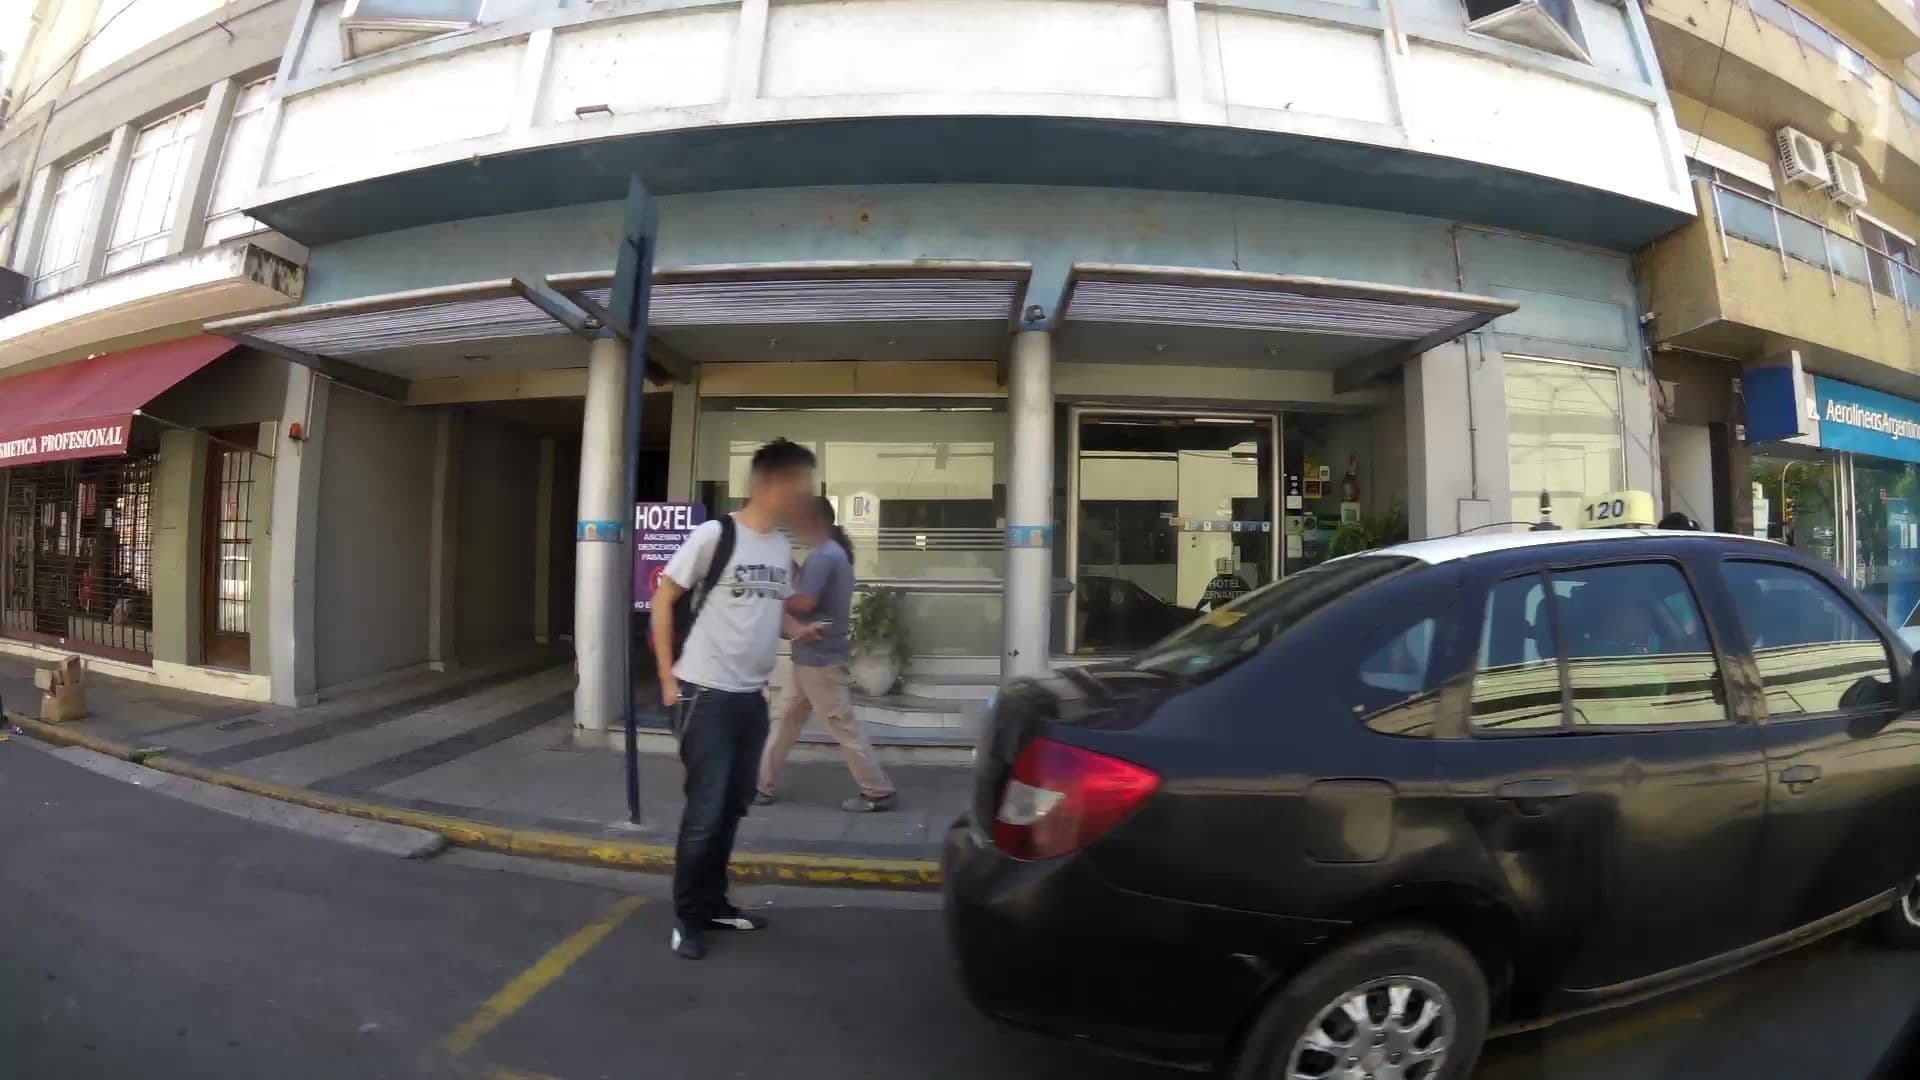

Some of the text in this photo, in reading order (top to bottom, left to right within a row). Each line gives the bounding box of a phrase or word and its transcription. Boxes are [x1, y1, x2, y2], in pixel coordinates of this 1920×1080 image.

[40, 426, 122, 453] PROFESIONAL
[635, 505, 697, 530] HOTEL
[1584, 499, 1624, 521] 120
